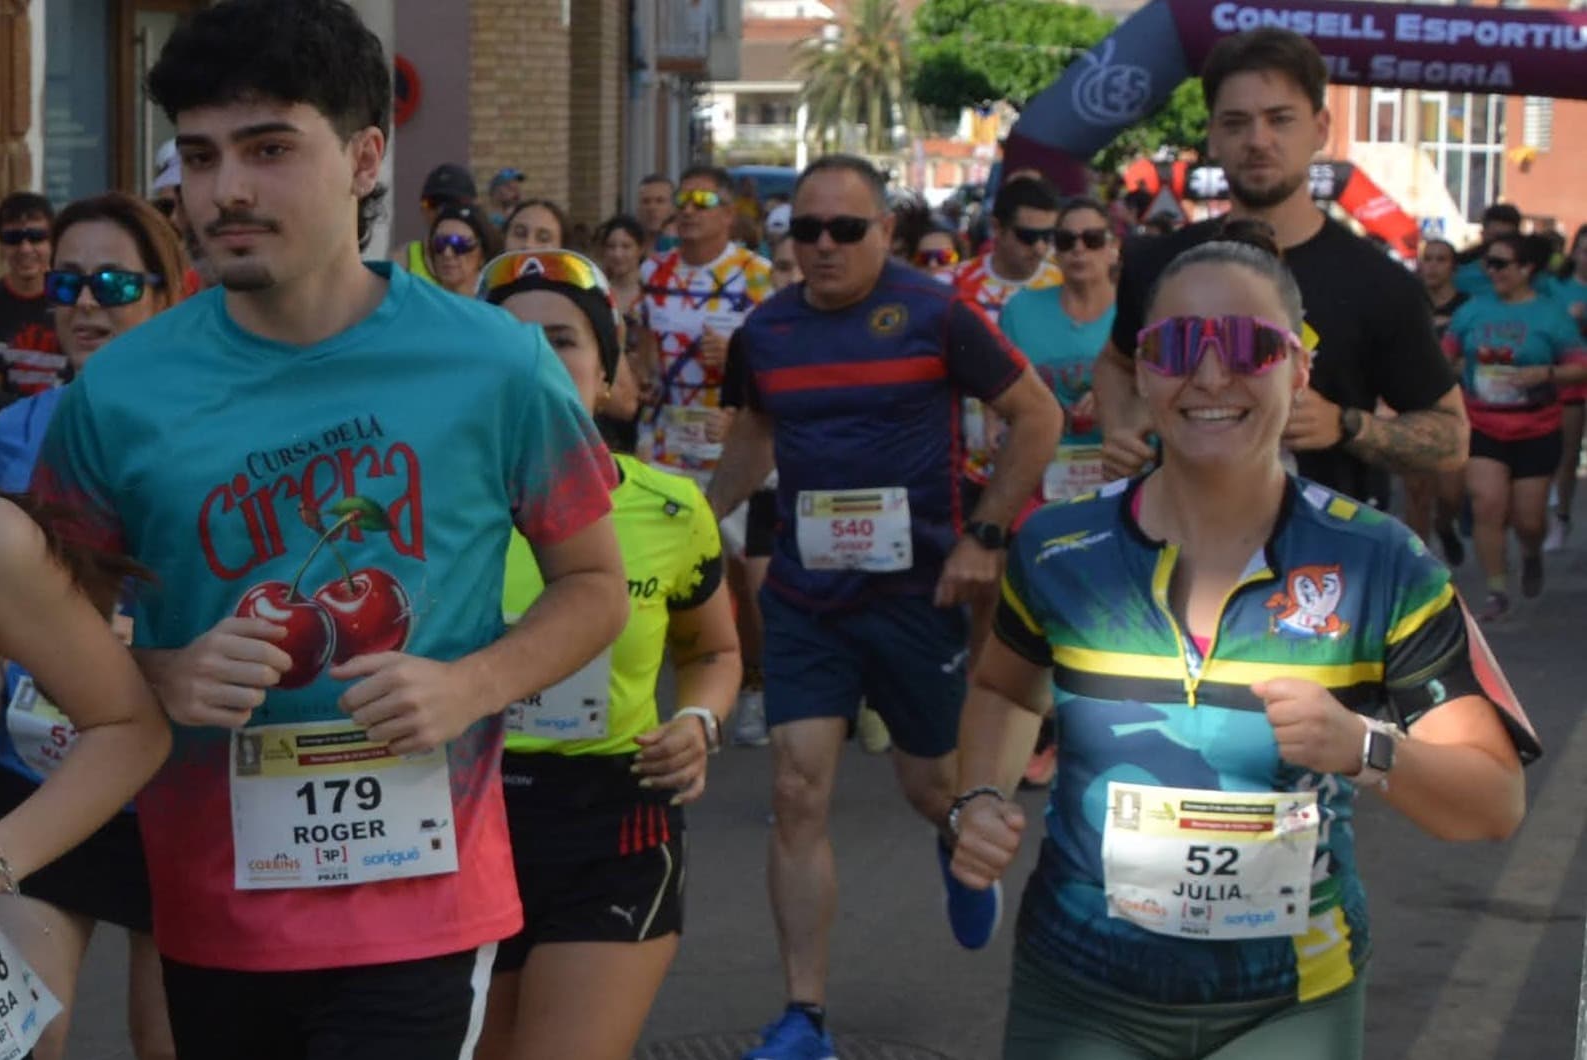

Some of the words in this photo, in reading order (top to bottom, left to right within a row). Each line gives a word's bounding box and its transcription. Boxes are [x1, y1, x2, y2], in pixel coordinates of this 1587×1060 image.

[1212, 2, 1385, 39] CONSELL
[1395, 13, 1587, 50] ESPORTIU
[246, 440, 320, 480] CURSA
[322, 422, 353, 447] DE
[353, 413, 385, 439] LA
[830, 520, 874, 538] 540
[296, 776, 383, 816] 179
[293, 819, 387, 844] ROGER
[1185, 845, 1240, 877] 52
